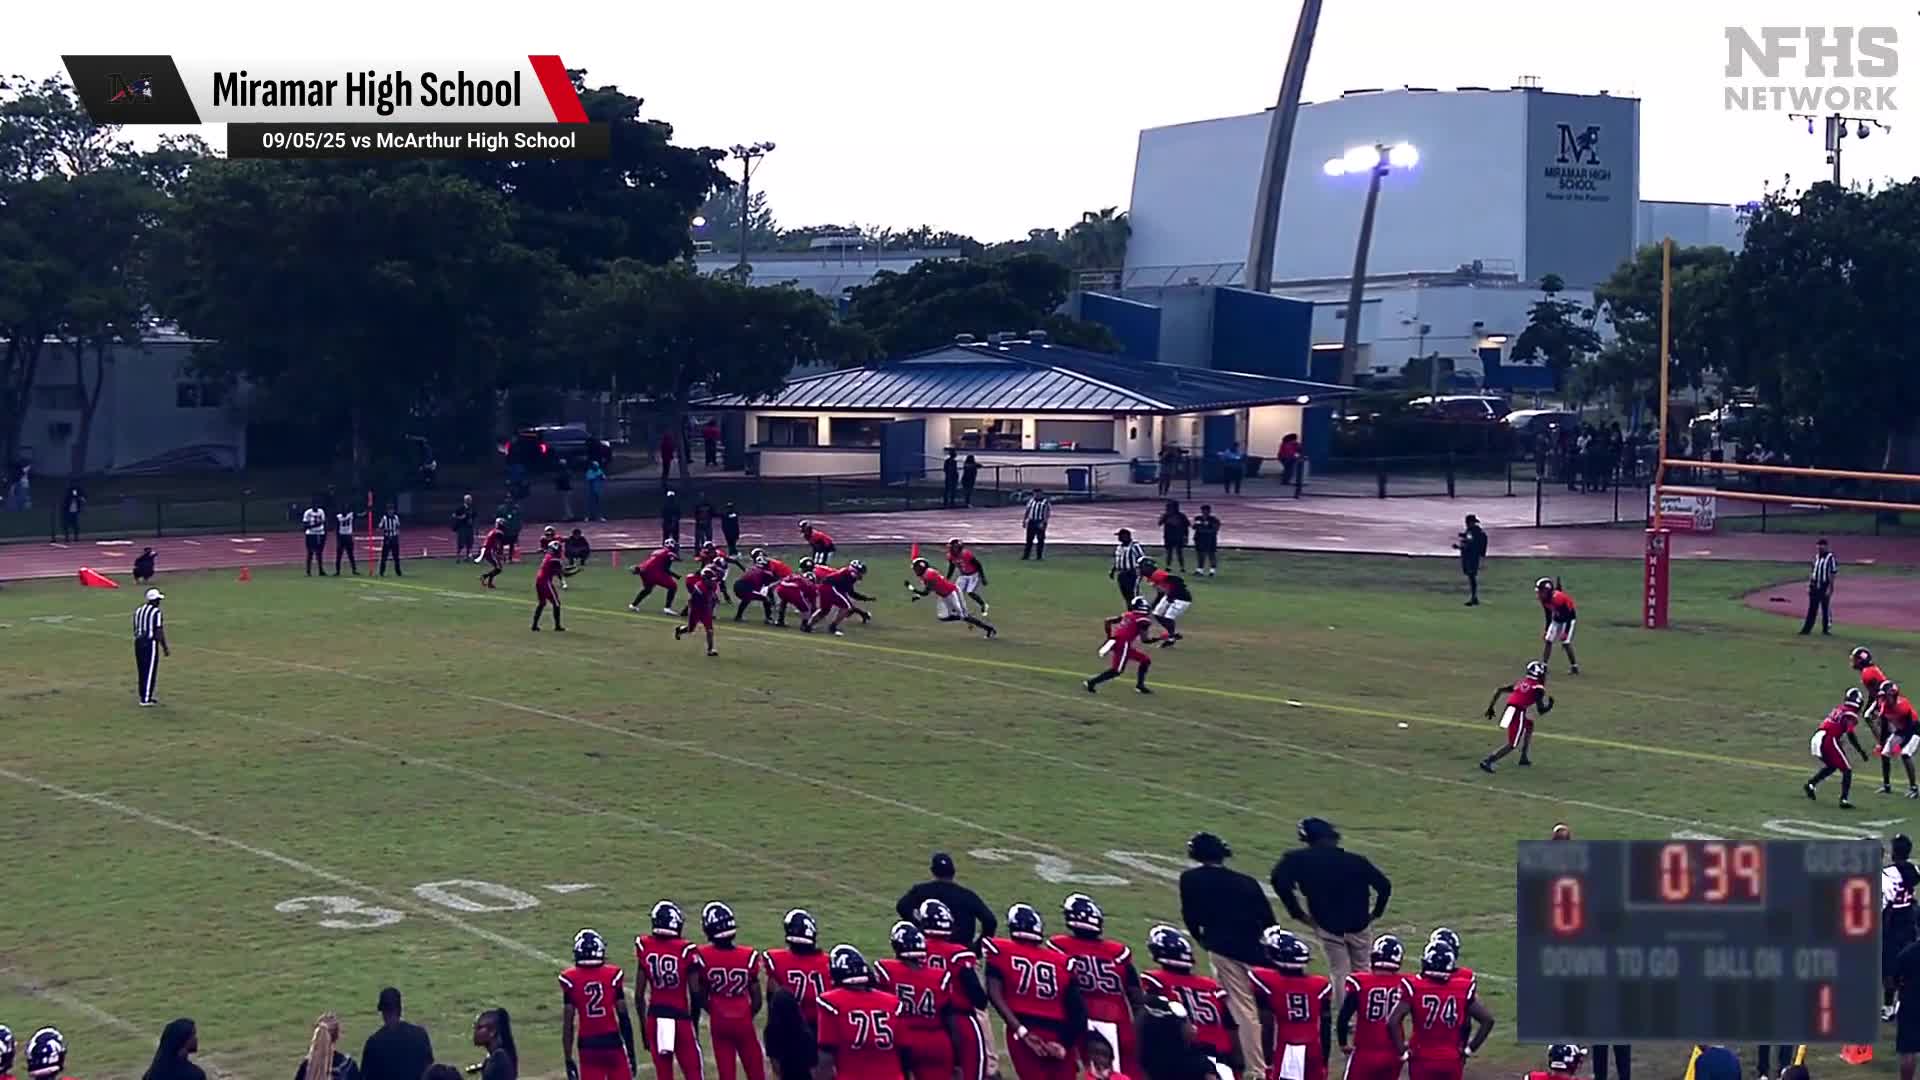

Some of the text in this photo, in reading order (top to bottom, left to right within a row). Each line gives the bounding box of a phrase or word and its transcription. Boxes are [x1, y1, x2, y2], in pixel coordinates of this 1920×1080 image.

[1544, 167, 1611, 181] MIRAMAR HIGH
[1559, 178, 1597, 192] SCHOOL
[275, 878, 541, 929] 30
[1552, 877, 1583, 933] 0
[1842, 878, 1873, 936] 0
[646, 952, 680, 989] 18
[1010, 956, 1057, 1000] 79
[1541, 947, 1839, 977] DOWN TO GO BALL ON QTR
[584, 980, 606, 1018] 2
[708, 967, 750, 997] 22
[896, 983, 936, 1019] 54
[1286, 993, 1310, 1021] 9
[1422, 994, 1458, 1029] 74
[1818, 984, 1833, 1034] 1
[849, 1010, 894, 1049] 75
